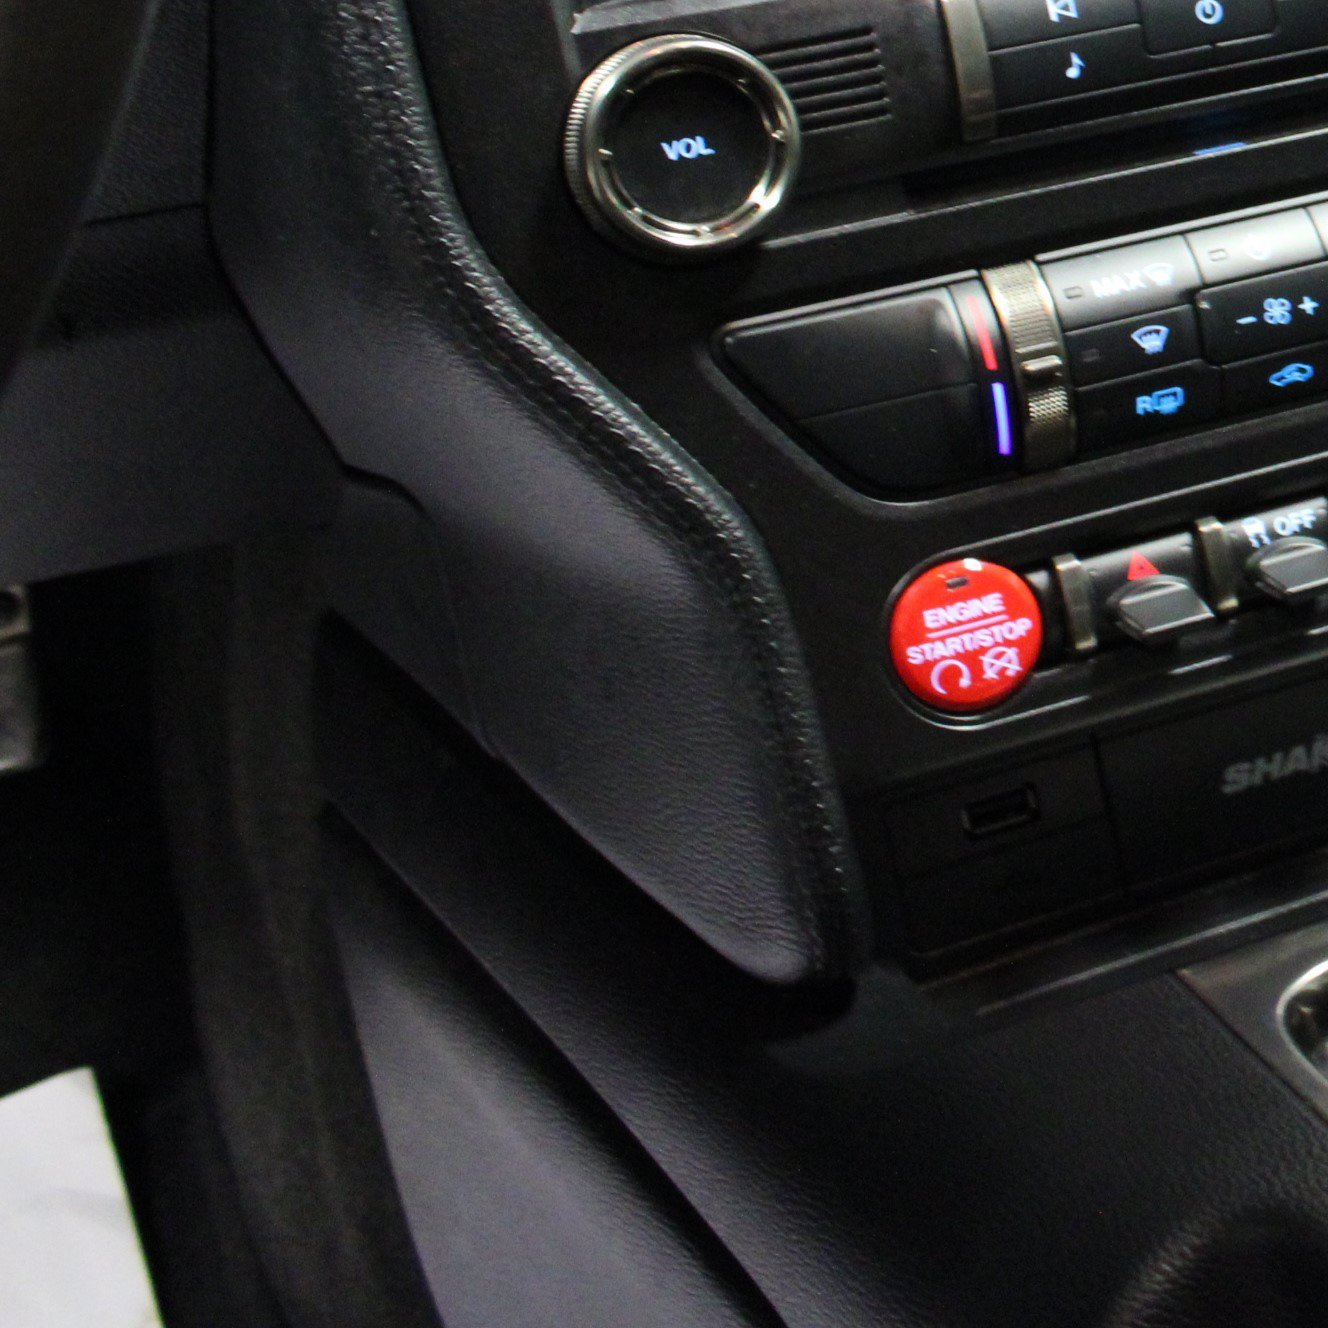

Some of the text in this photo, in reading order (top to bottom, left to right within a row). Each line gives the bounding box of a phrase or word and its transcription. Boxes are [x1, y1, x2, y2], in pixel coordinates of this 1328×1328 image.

[660, 135, 716, 162] VOL
[1090, 270, 1144, 299] MAX
[1272, 508, 1317, 536] OFF
[923, 592, 1005, 630] ENGINE
[906, 616, 1032, 666] START/STOP
